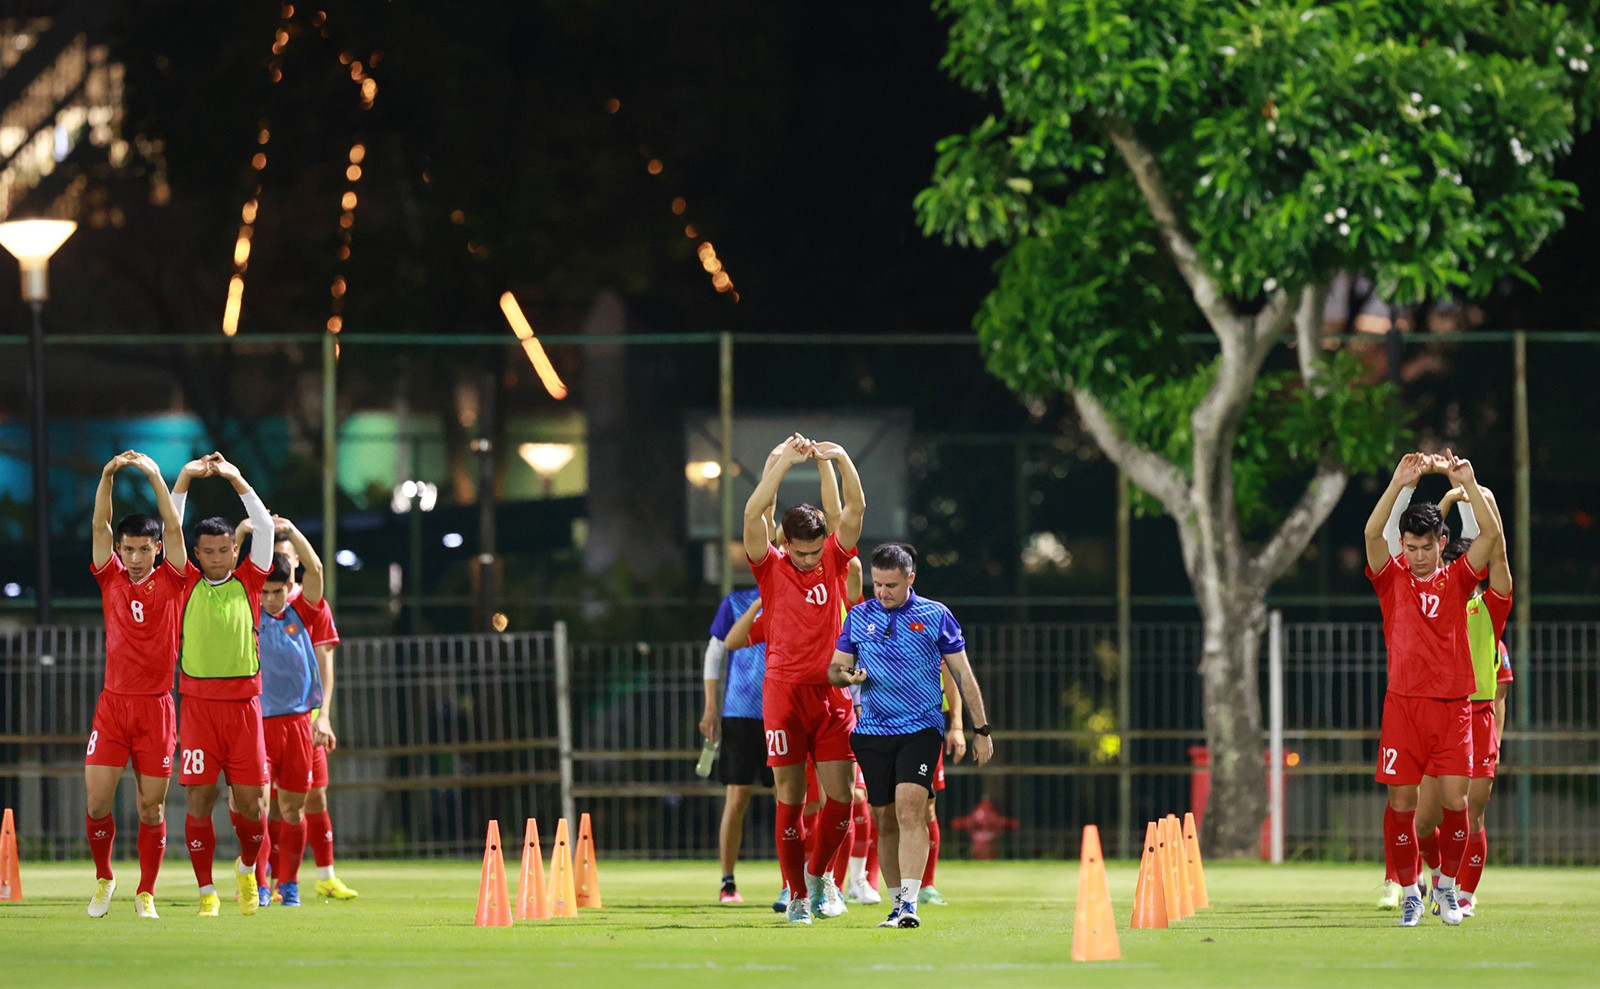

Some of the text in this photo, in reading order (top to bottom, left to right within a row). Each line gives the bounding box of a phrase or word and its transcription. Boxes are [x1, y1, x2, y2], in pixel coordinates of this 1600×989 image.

[131, 600, 144, 623] 8
[1419, 592, 1440, 618] 12
[86, 730, 98, 755] 8
[765, 729, 789, 756] 20
[183, 749, 205, 775] 28
[1382, 747, 1398, 775] 12
